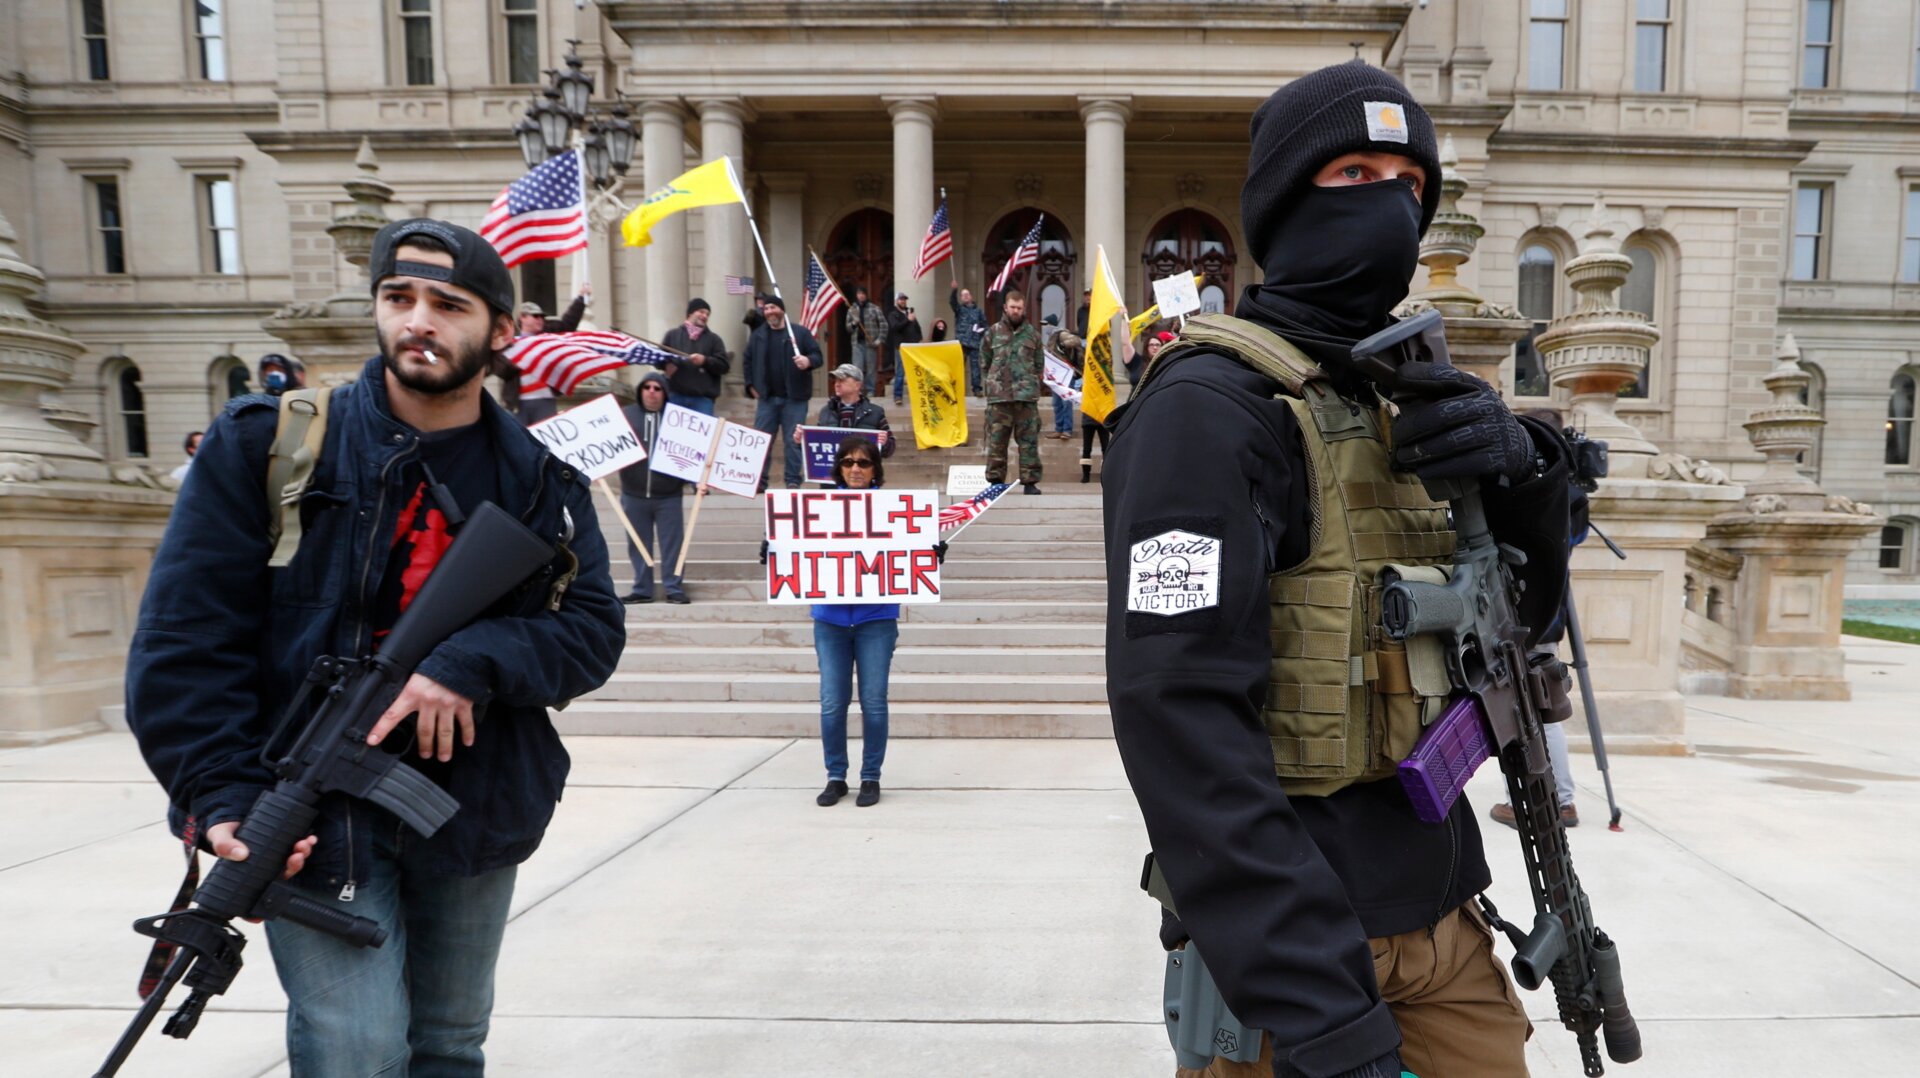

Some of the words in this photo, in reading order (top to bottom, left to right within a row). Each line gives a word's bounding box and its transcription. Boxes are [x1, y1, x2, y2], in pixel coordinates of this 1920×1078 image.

[536, 418, 579, 448] ND
[667, 409, 711, 437] OPEN
[565, 430, 639, 472] CKDOWN
[659, 437, 706, 463] MICHIGAN
[726, 427, 766, 449] STOP
[730, 453, 750, 463] the
[767, 493, 893, 540] HEIL
[1133, 538, 1217, 563] Death
[769, 550, 939, 599] WITMER
[1134, 593, 1210, 609] VICTORY
